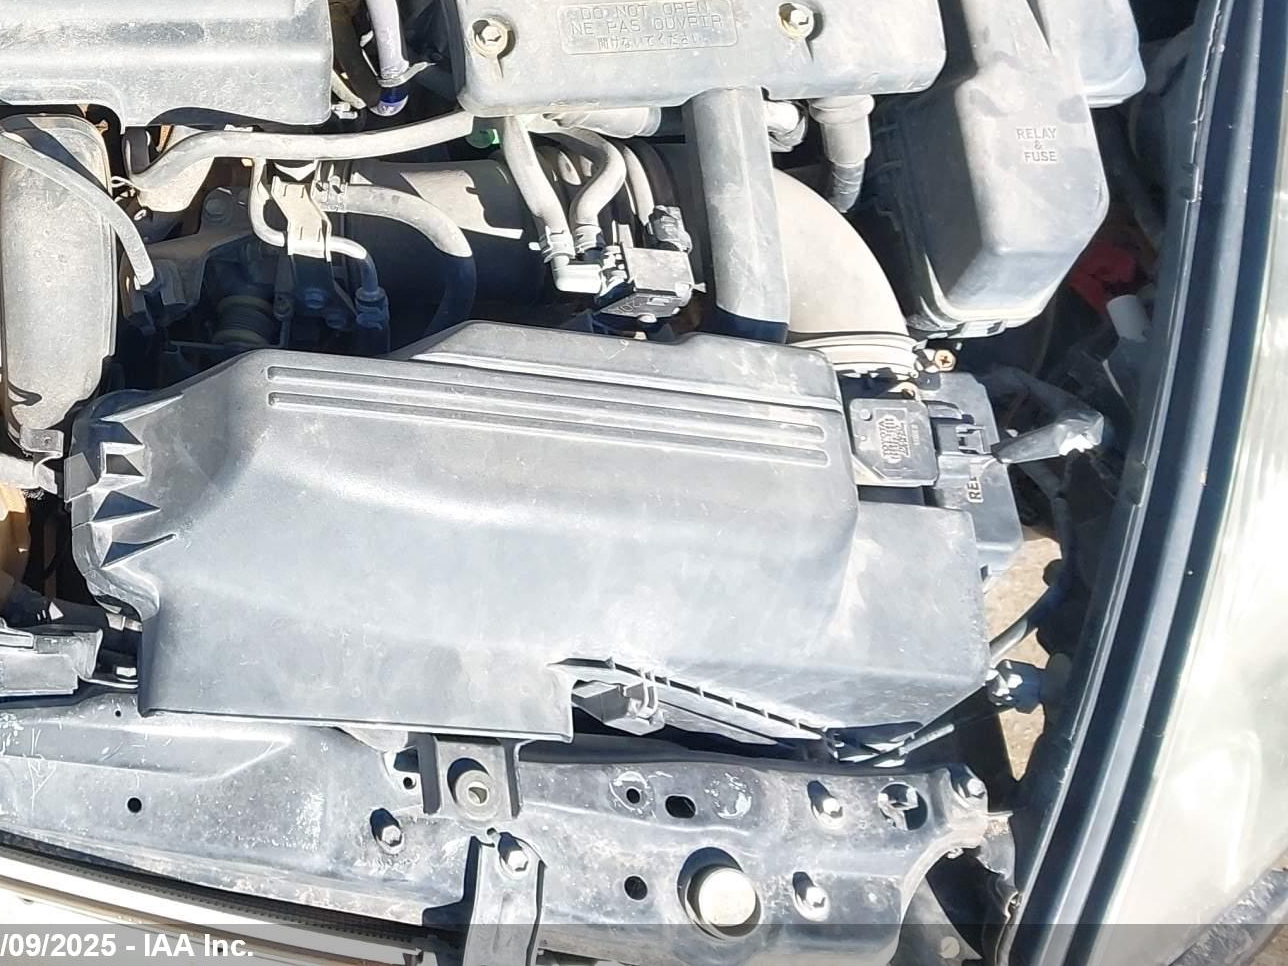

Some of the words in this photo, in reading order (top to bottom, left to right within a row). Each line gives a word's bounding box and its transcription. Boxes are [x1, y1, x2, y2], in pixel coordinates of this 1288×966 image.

[580, 7, 604, 20] DO
[616, 4, 648, 19] NOT
[662, 0, 709, 16] OPEN
[571, 22, 594, 35] NE
[606, 17, 641, 34] PAS
[653, 14, 722, 31] OUVRIR
[1015, 127, 1057, 140] RELAY
[1034, 140, 1043, 150] &
[1024, 151, 1057, 163] FUSE
